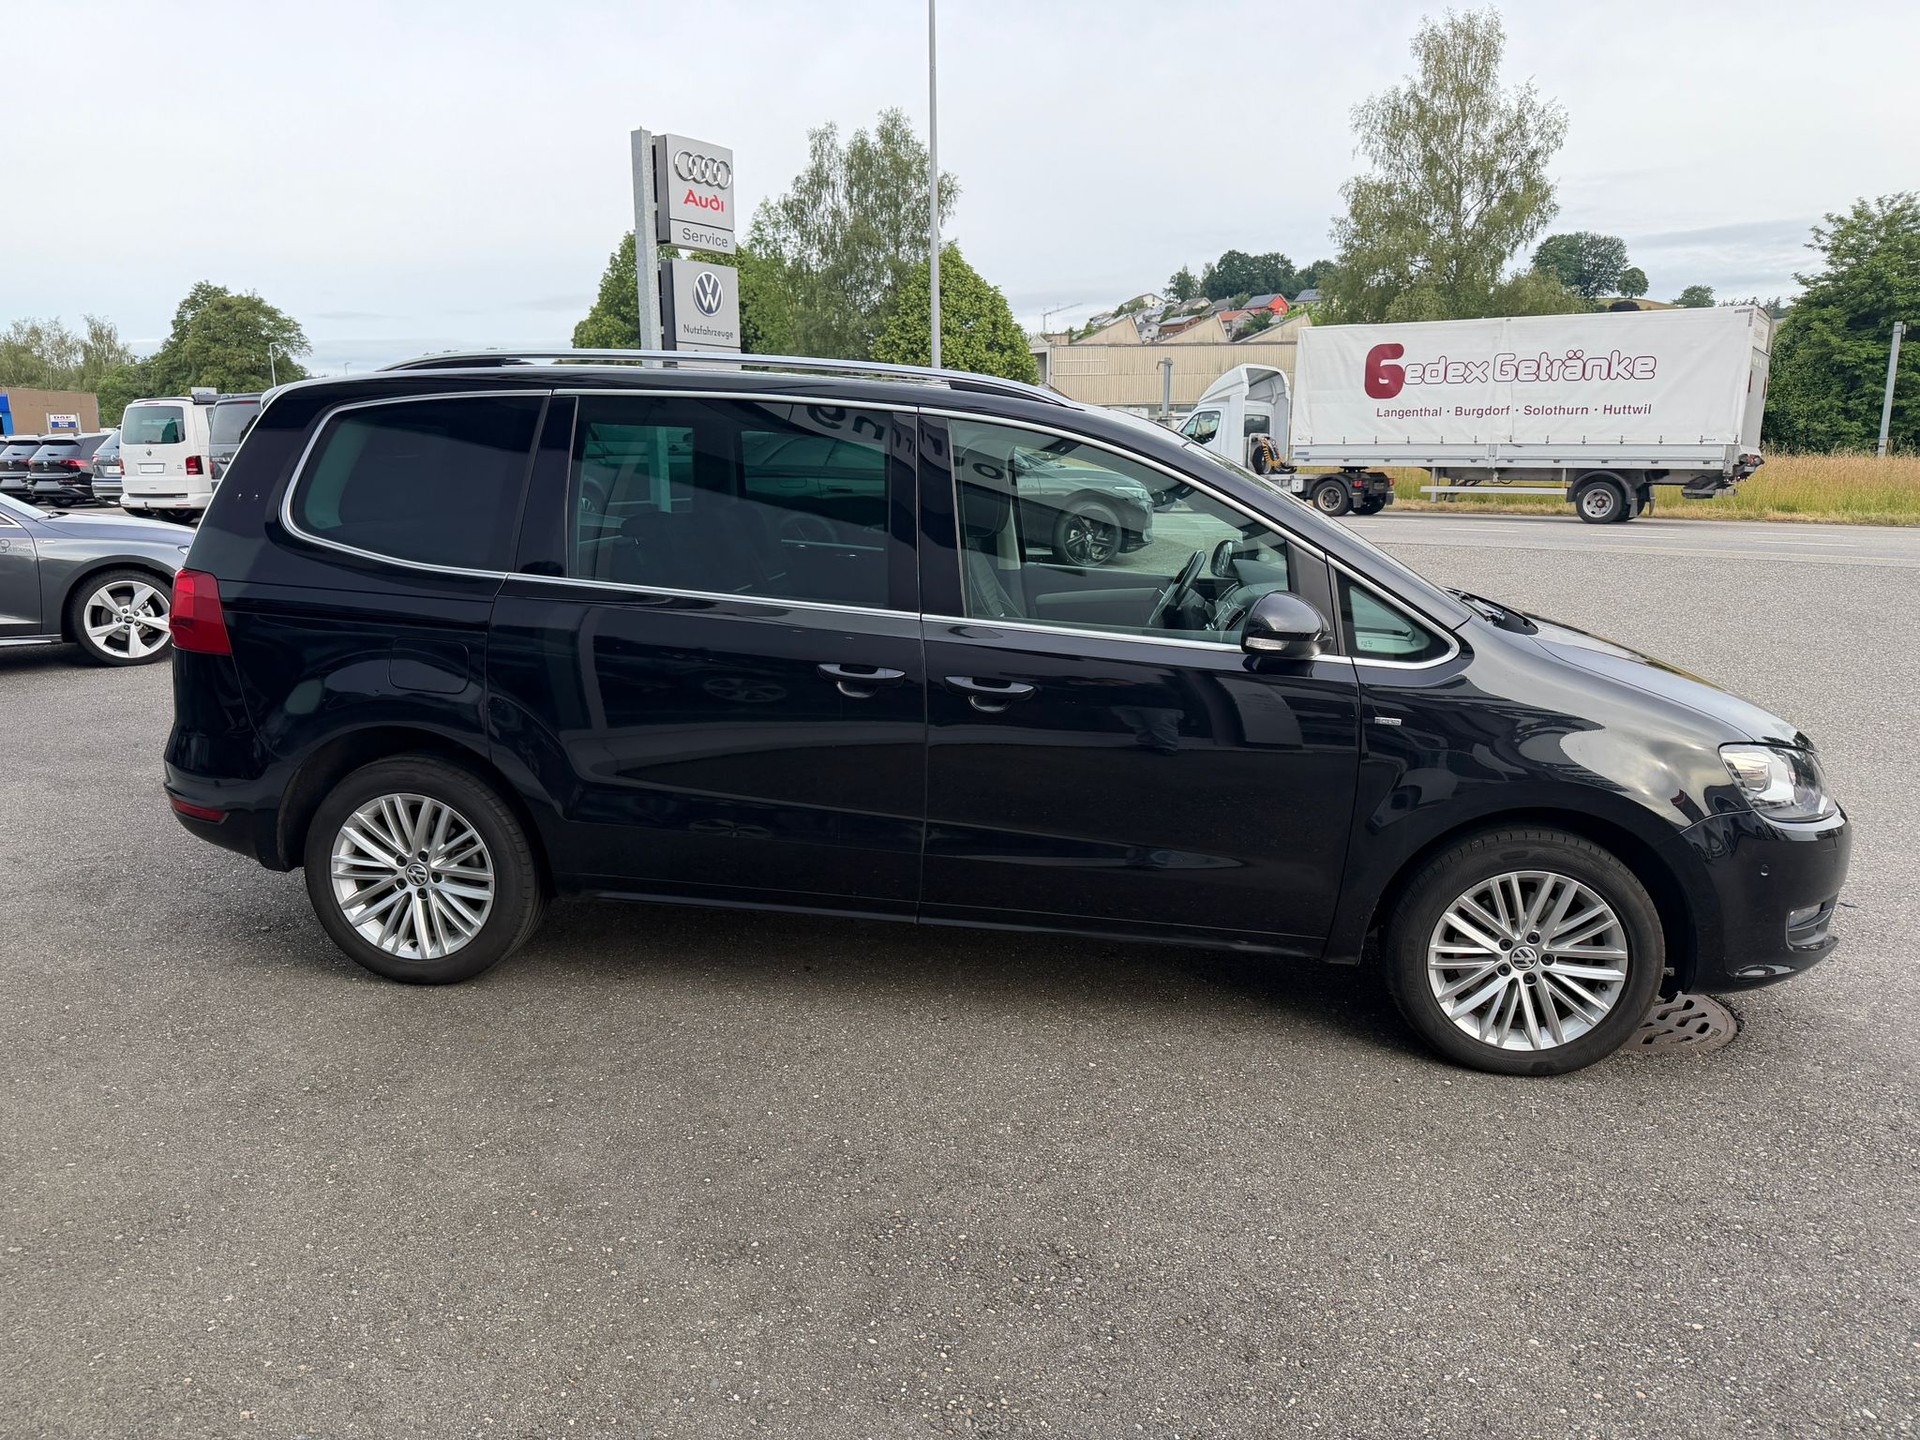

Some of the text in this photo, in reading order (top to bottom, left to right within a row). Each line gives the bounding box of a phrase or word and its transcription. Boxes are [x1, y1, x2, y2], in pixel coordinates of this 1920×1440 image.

[683, 188, 725, 213] Audi
[682, 227, 728, 248] Service
[683, 323, 734, 340] Nutzfahrzeuge
[1364, 343, 1657, 399] Gedex Getränke
[1376, 403, 1652, 420] Langenthal Burgdorf Solothurn Huttwil
